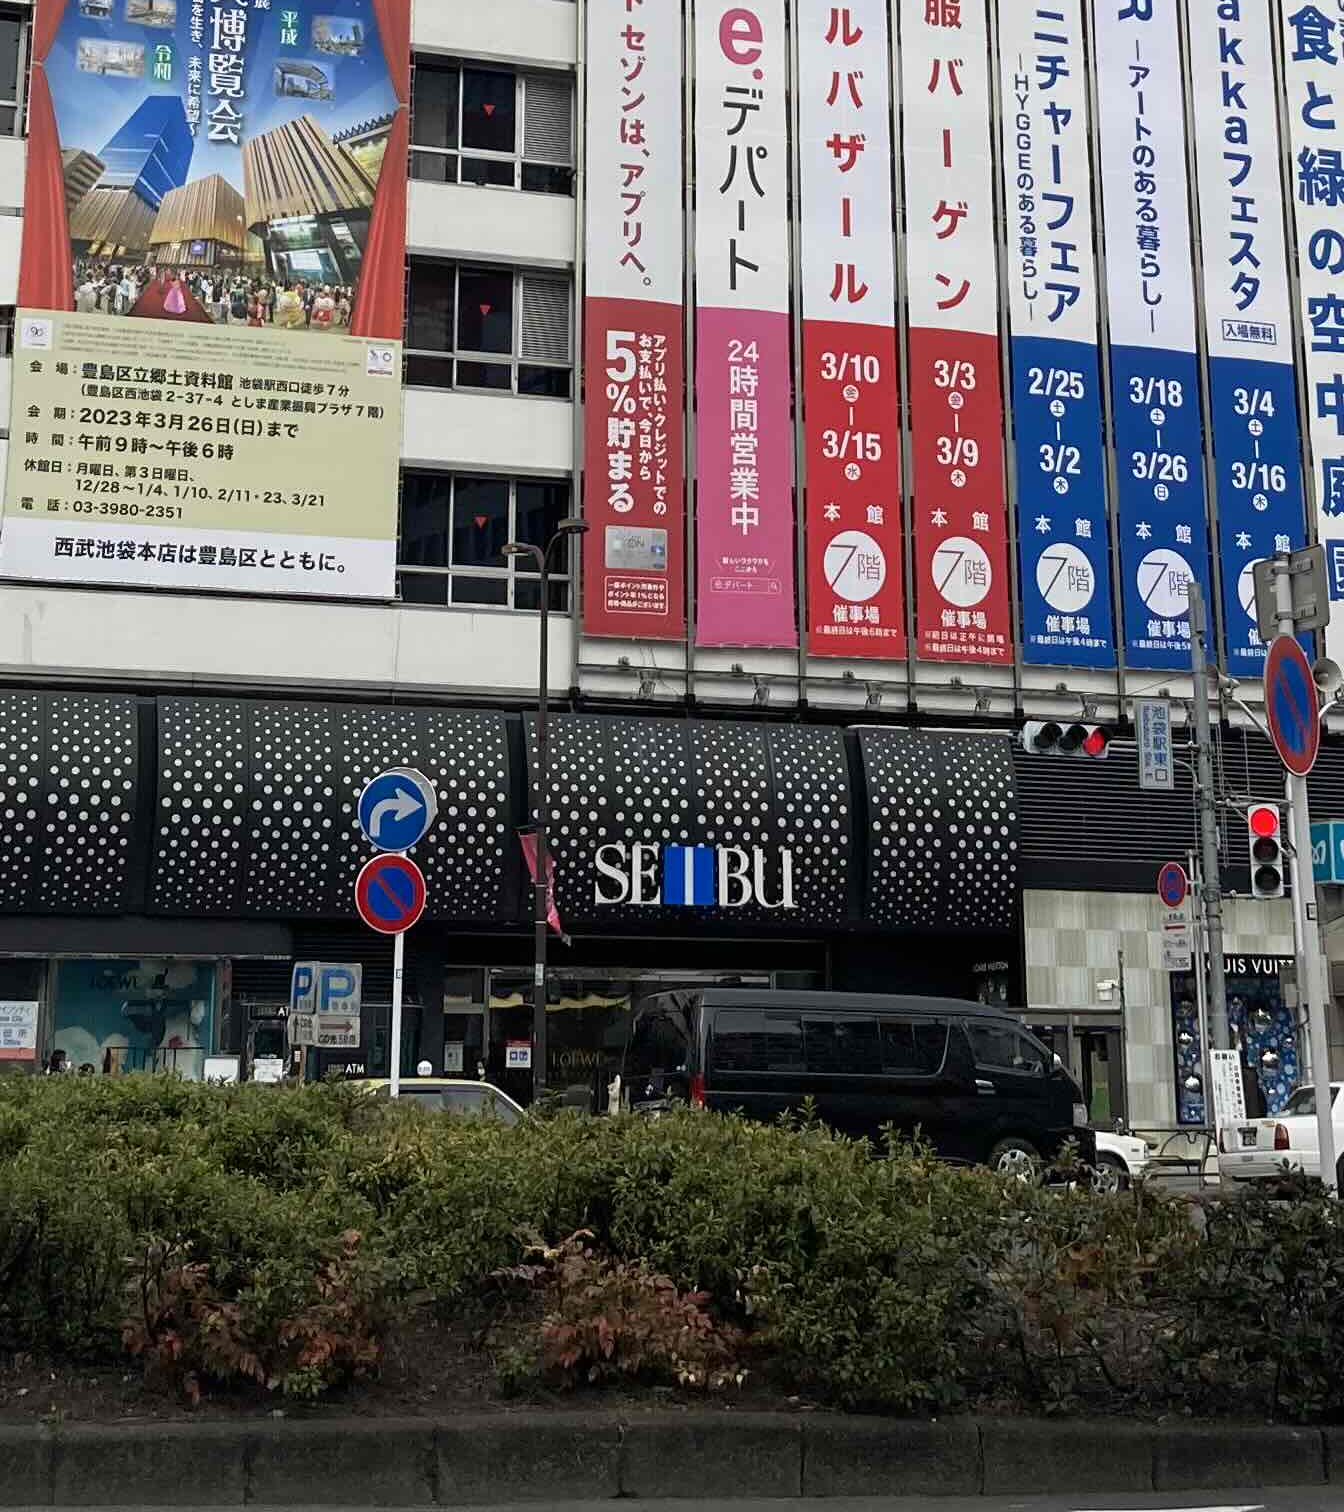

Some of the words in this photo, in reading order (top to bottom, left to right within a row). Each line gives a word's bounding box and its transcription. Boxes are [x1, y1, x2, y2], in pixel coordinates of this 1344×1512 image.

[279, 10, 298, 47] 平成
[153, 45, 173, 82] 令和
[1225, 323, 1274, 342] 入場無料
[820, 351, 880, 384] 3/10
[934, 359, 976, 390] 3/3
[1027, 367, 1084, 399] 2/25
[1129, 376, 1182, 408] 3/18
[1234, 388, 1275, 417] 3/4
[728, 339, 760, 536] 24時間営業中
[822, 430, 882, 462] 3/15
[936, 437, 979, 468] 3/9
[1039, 445, 1080, 475] 3/2
[1132, 452, 1188, 483] 3/26
[1231, 462, 1286, 492] 3/16
[72, 500, 184, 520] 03-3980-2351
[54, 537, 346, 574] 西武池袋本店は豊島区とともに。
[830, 544, 881, 590] 7階
[937, 549, 987, 594] 7階
[1042, 555, 1090, 599] 7階
[832, 604, 881, 625] 催事場
[941, 608, 986, 630] 催事場
[1045, 615, 1091, 636] 催事場
[594, 843, 799, 908] SEIBU
[294, 967, 312, 1009] P
[320, 968, 355, 1011] P
[346, 1064, 364, 1074] ATM
